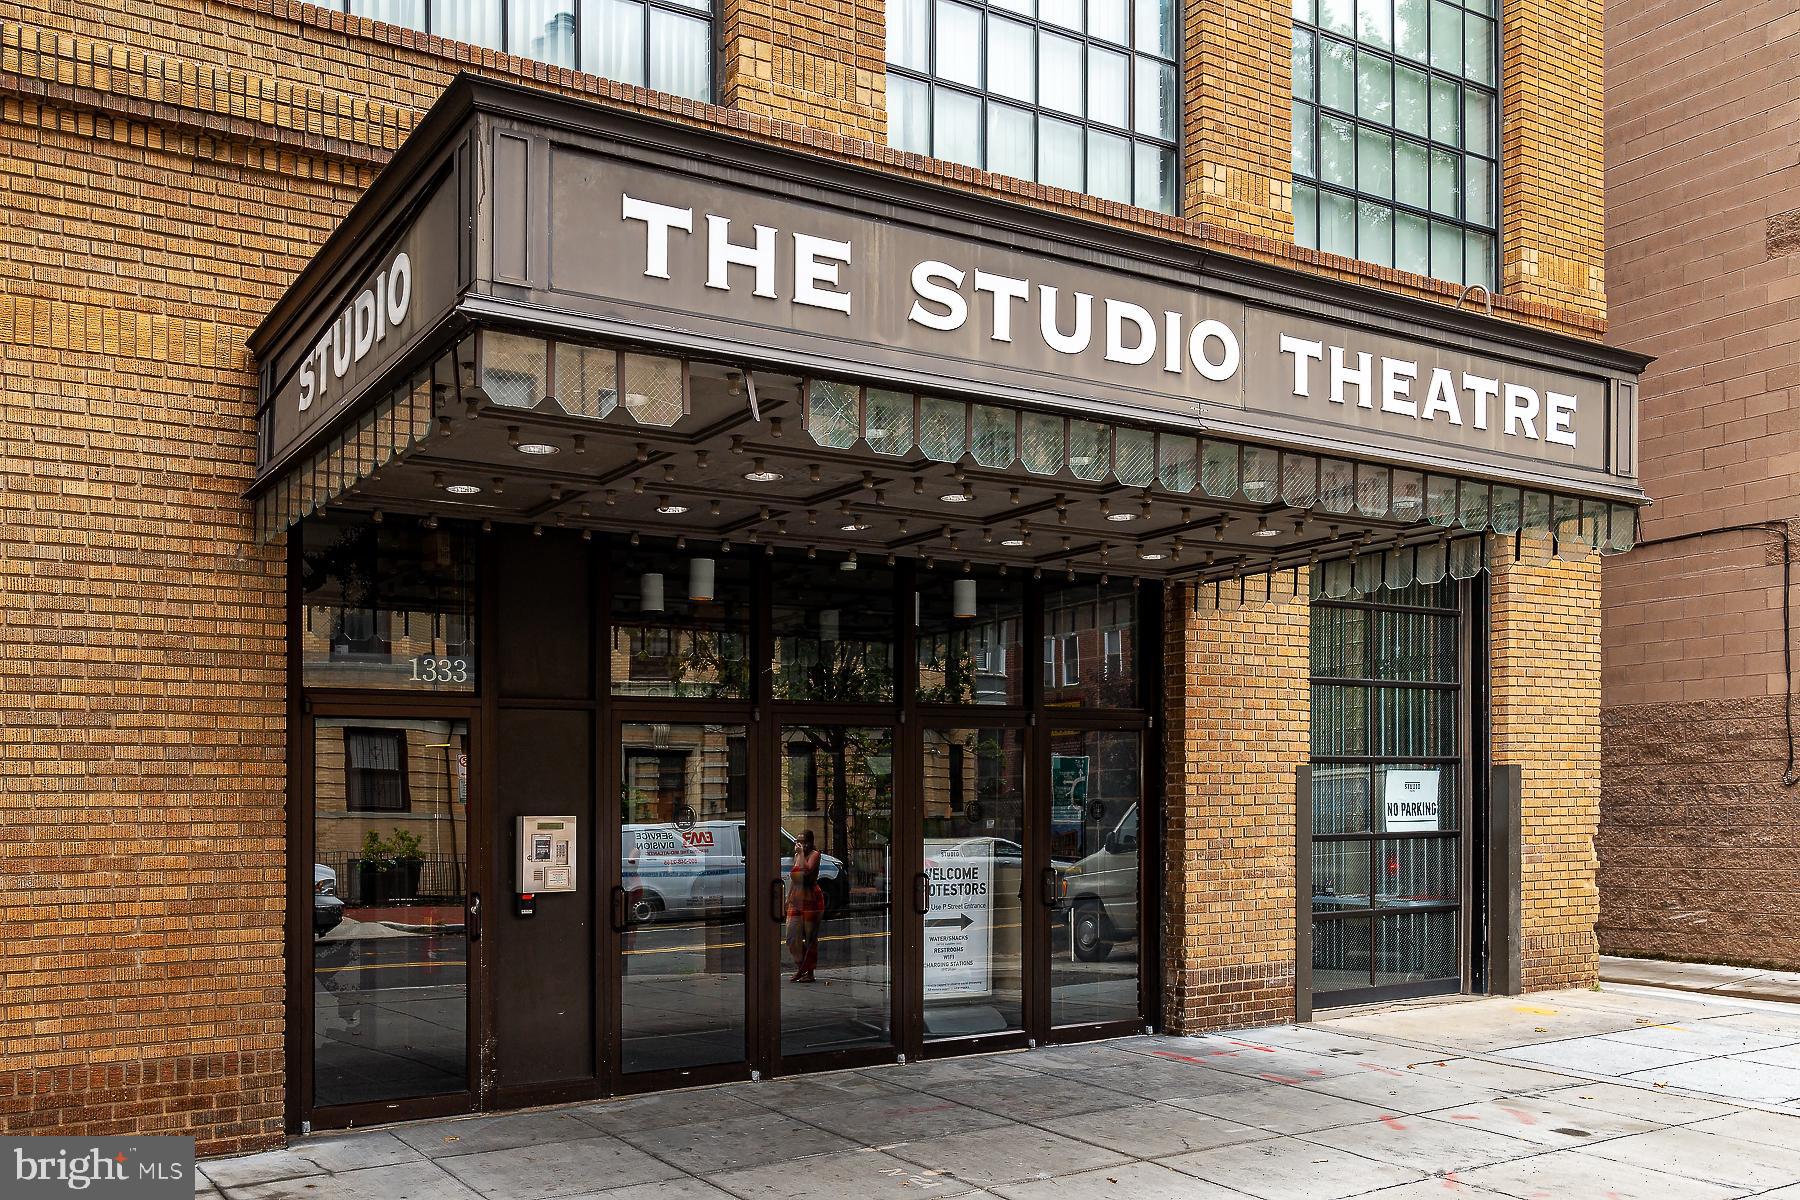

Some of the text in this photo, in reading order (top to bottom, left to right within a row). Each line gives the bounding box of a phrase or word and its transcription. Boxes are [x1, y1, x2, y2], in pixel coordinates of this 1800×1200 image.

[622, 192, 1577, 449] THE STUDIO THEATRE
[299, 252, 412, 412] STUDIO
[408, 657, 467, 683] 1333
[1386, 801, 1437, 817] NO PARKING
[929, 882, 987, 897] OTESTORS
[963, 902, 987, 910] Entrance
[933, 946, 964, 954] RESTROOMS
[950, 959, 974, 967] STATIONS
